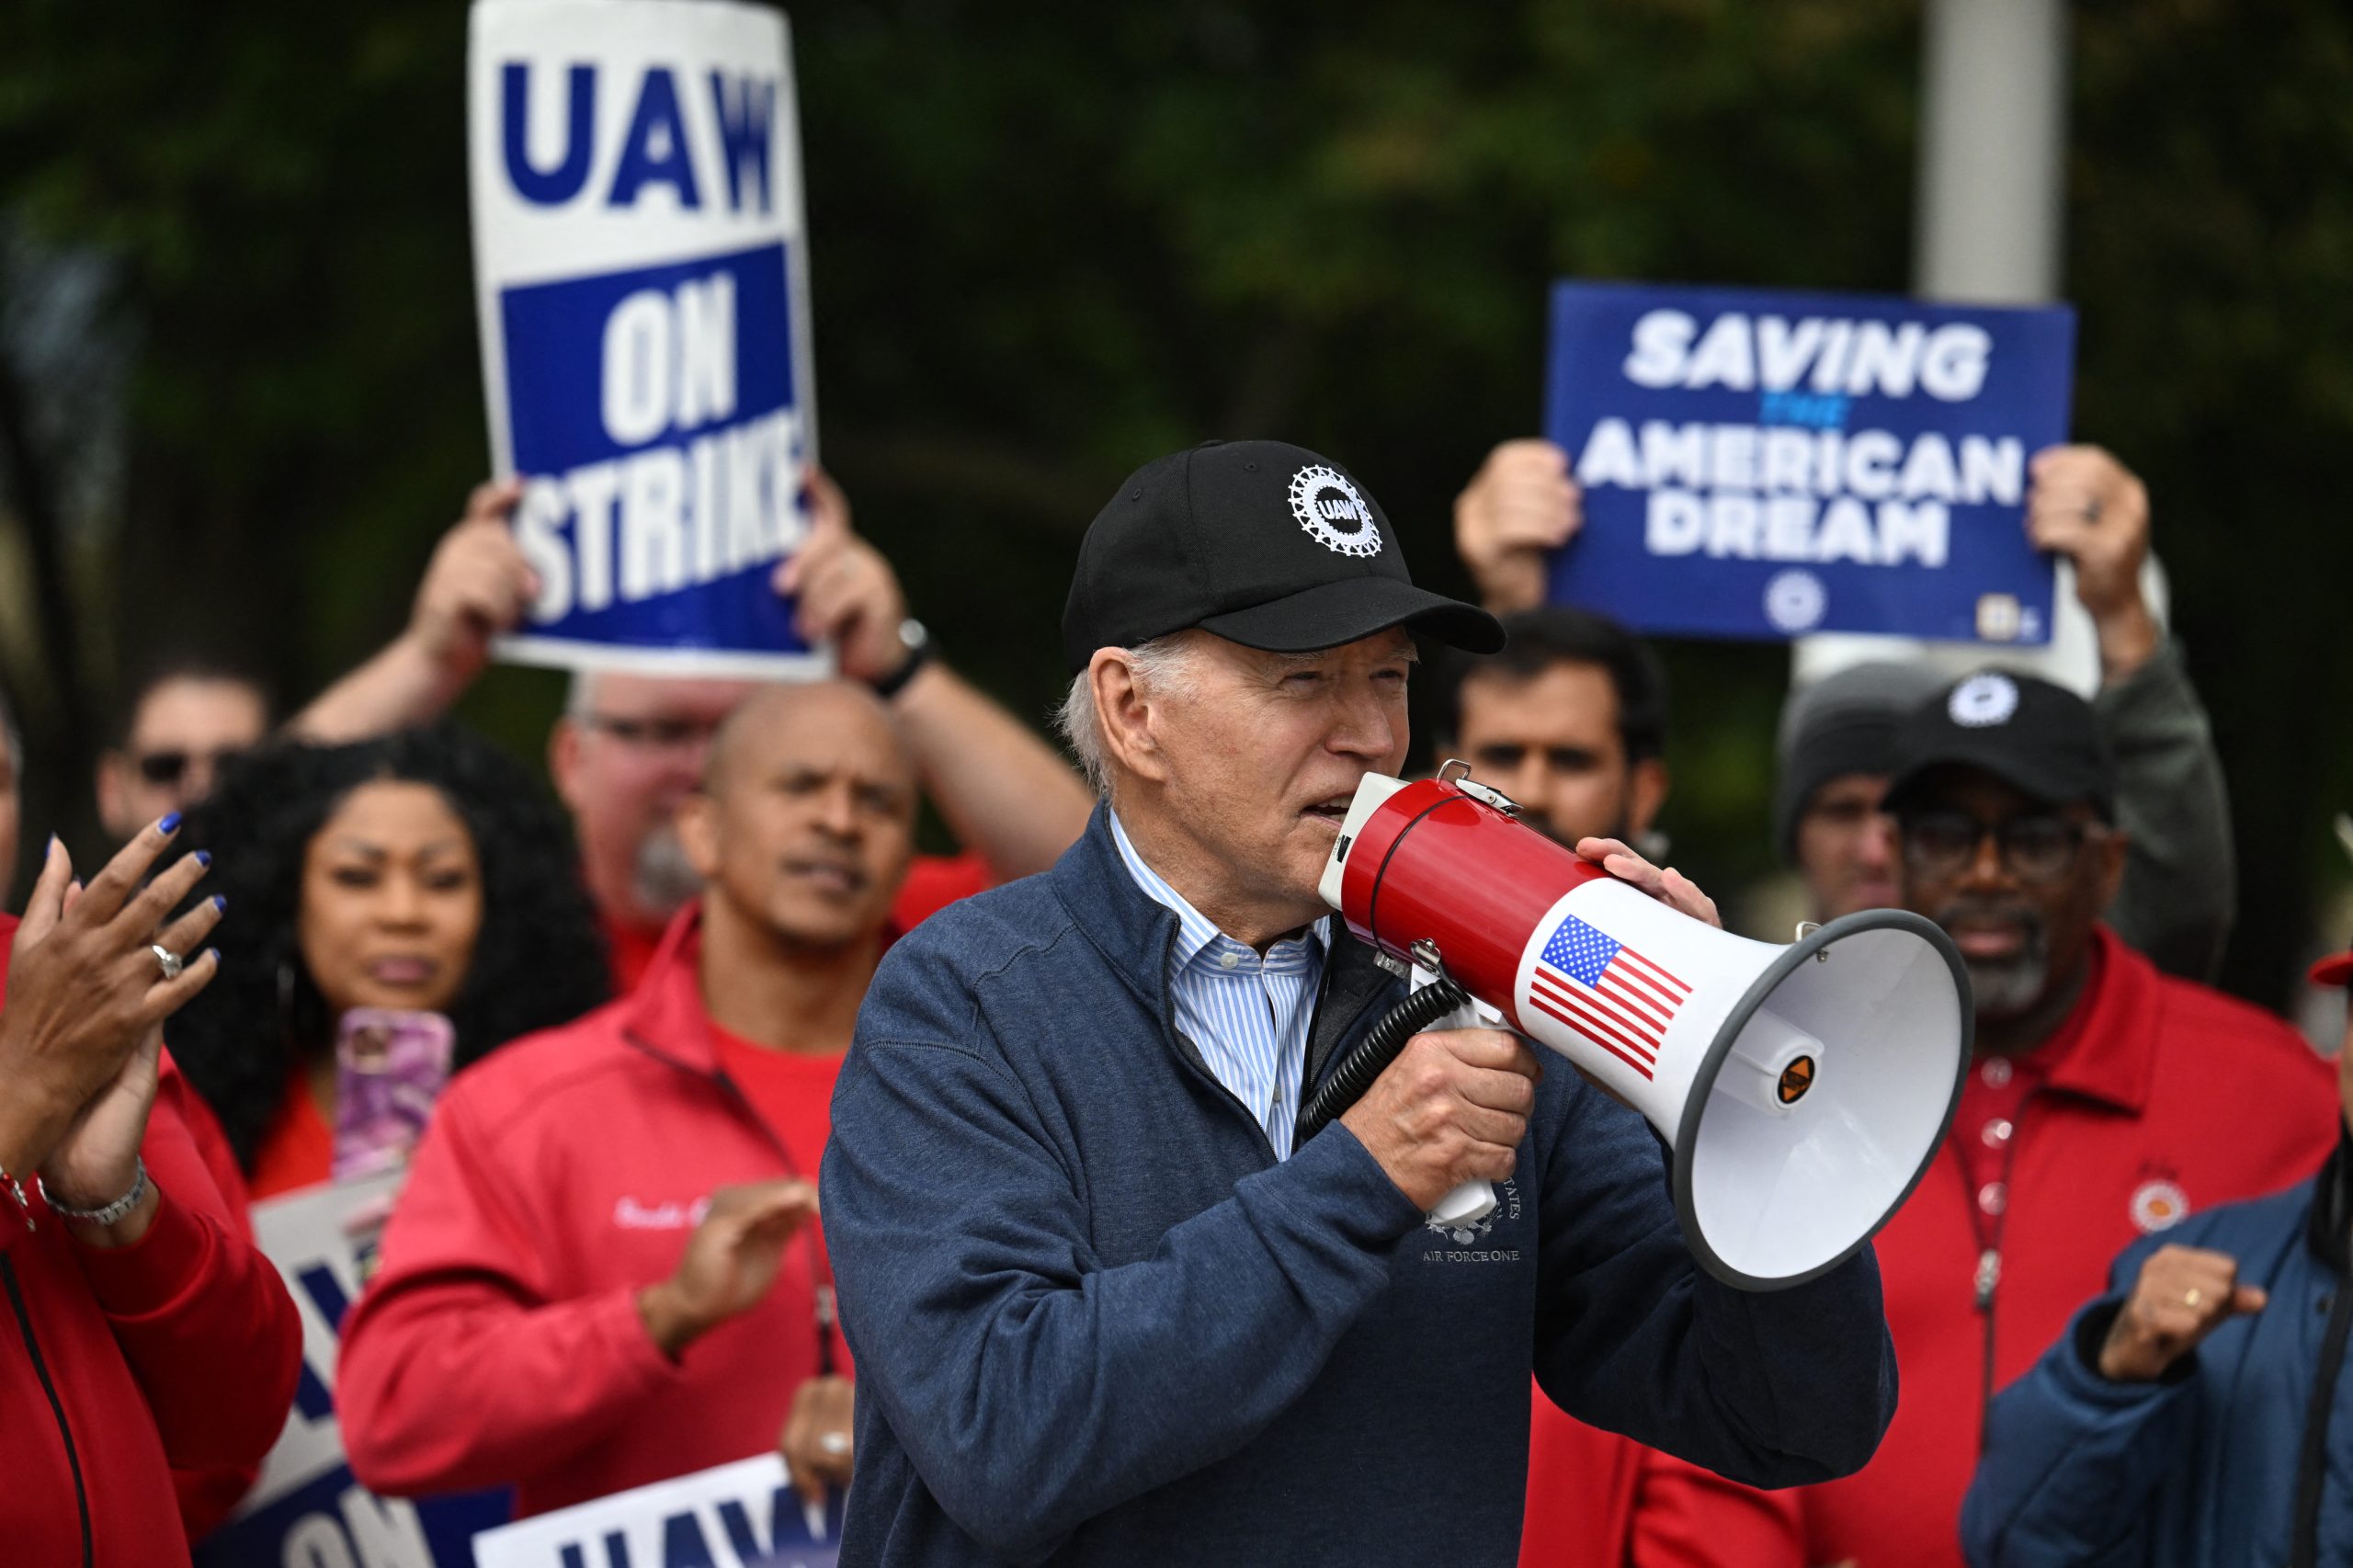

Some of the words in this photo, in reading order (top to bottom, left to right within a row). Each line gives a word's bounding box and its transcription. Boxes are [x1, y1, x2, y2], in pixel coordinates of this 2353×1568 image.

[499, 62, 778, 217] UAW
[602, 270, 736, 447] ON
[1624, 310, 1991, 400] SAVING
[1575, 417, 2023, 505] AMERICAN
[517, 407, 809, 625] STRIKE
[1317, 499, 1358, 520] UAW
[1645, 489, 1949, 568] DREAM
[1503, 1176, 1521, 1220] TATES
[1423, 1250, 1443, 1262] AIR
[1446, 1251, 1489, 1263] FORCE
[1491, 1250, 1520, 1262] ONE
